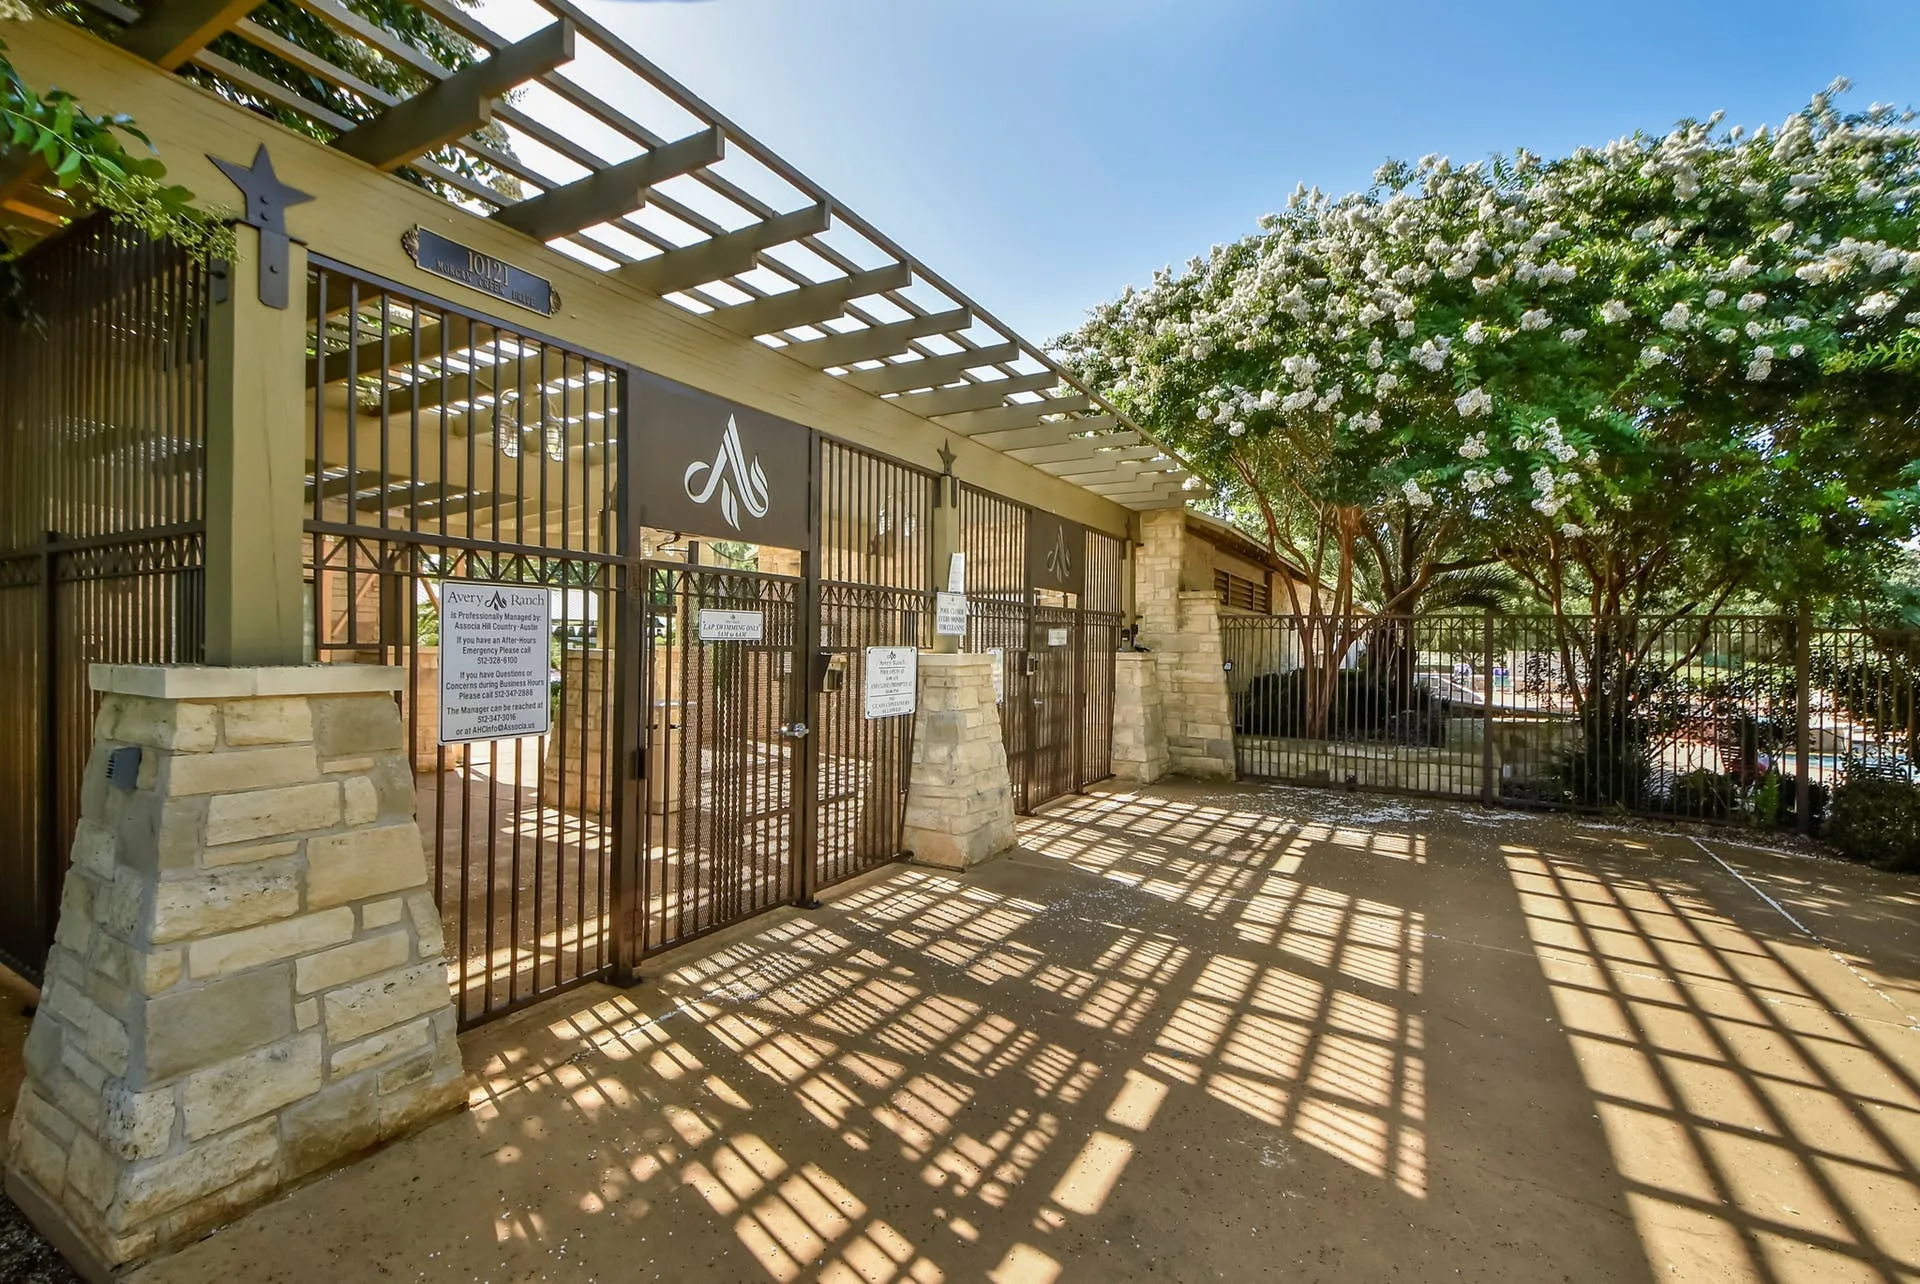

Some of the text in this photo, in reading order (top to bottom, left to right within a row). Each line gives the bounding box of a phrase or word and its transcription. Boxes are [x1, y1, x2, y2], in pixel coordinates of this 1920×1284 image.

[468, 250, 508, 286] 10121
[436, 258, 474, 282] MORGAN
[478, 278, 504, 296] CREEK
[448, 592, 544, 606] Avery Ranch
[458, 612, 502, 622] Professionally
[504, 613, 532, 622] Managed
[532, 614, 541, 622] by:
[454, 622, 480, 630] Associa
[482, 622, 491, 630] Hill
[456, 636, 462, 644] If
[476, 636, 491, 644] have
[502, 636, 536, 644] After-Hours
[462, 646, 531, 655] Emergency Please call
[477, 656, 518, 664] 512-328-6100
[466, 672, 478, 680] you
[496, 670, 525, 678] Questions
[446, 682, 477, 690] Concerns
[478, 681, 498, 689] during
[500, 680, 526, 688] Business
[459, 692, 480, 700] Please
[447, 707, 459, 715] The
[461, 706, 489, 714] Manager
[512, 702, 536, 710] reached
[478, 713, 516, 723] 512-347-3016
